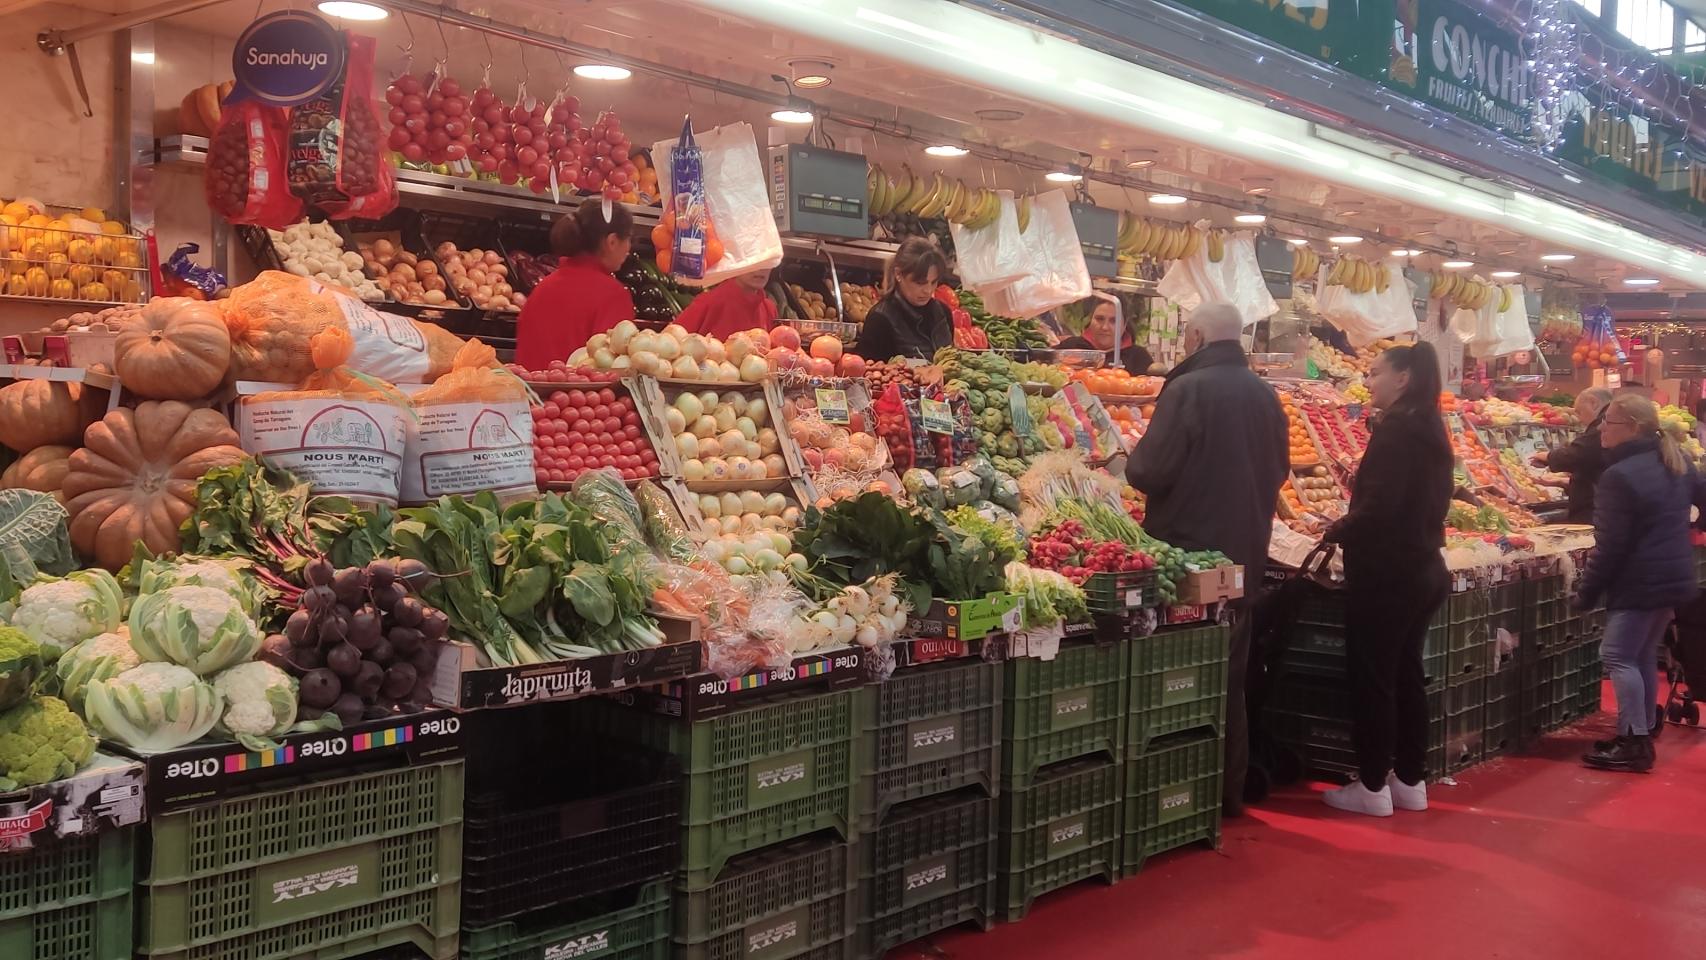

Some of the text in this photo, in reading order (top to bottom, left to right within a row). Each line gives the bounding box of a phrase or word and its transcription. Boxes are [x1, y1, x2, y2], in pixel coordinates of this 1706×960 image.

[247, 47, 327, 70] Sanahuja
[304, 453, 343, 461] NOUS
[922, 640, 956, 656] Divino
[835, 655, 858, 668] QTee
[699, 679, 727, 695] QTee
[419, 717, 460, 735] QTee
[301, 736, 347, 757] QTee
[914, 733, 954, 747] KATY
[167, 757, 219, 778] QTee
[758, 770, 804, 789] KATY
[272, 874, 358, 904] KATY
[907, 871, 946, 890] KATY
[545, 930, 609, 956] KATY
[749, 929, 796, 952] KATY
